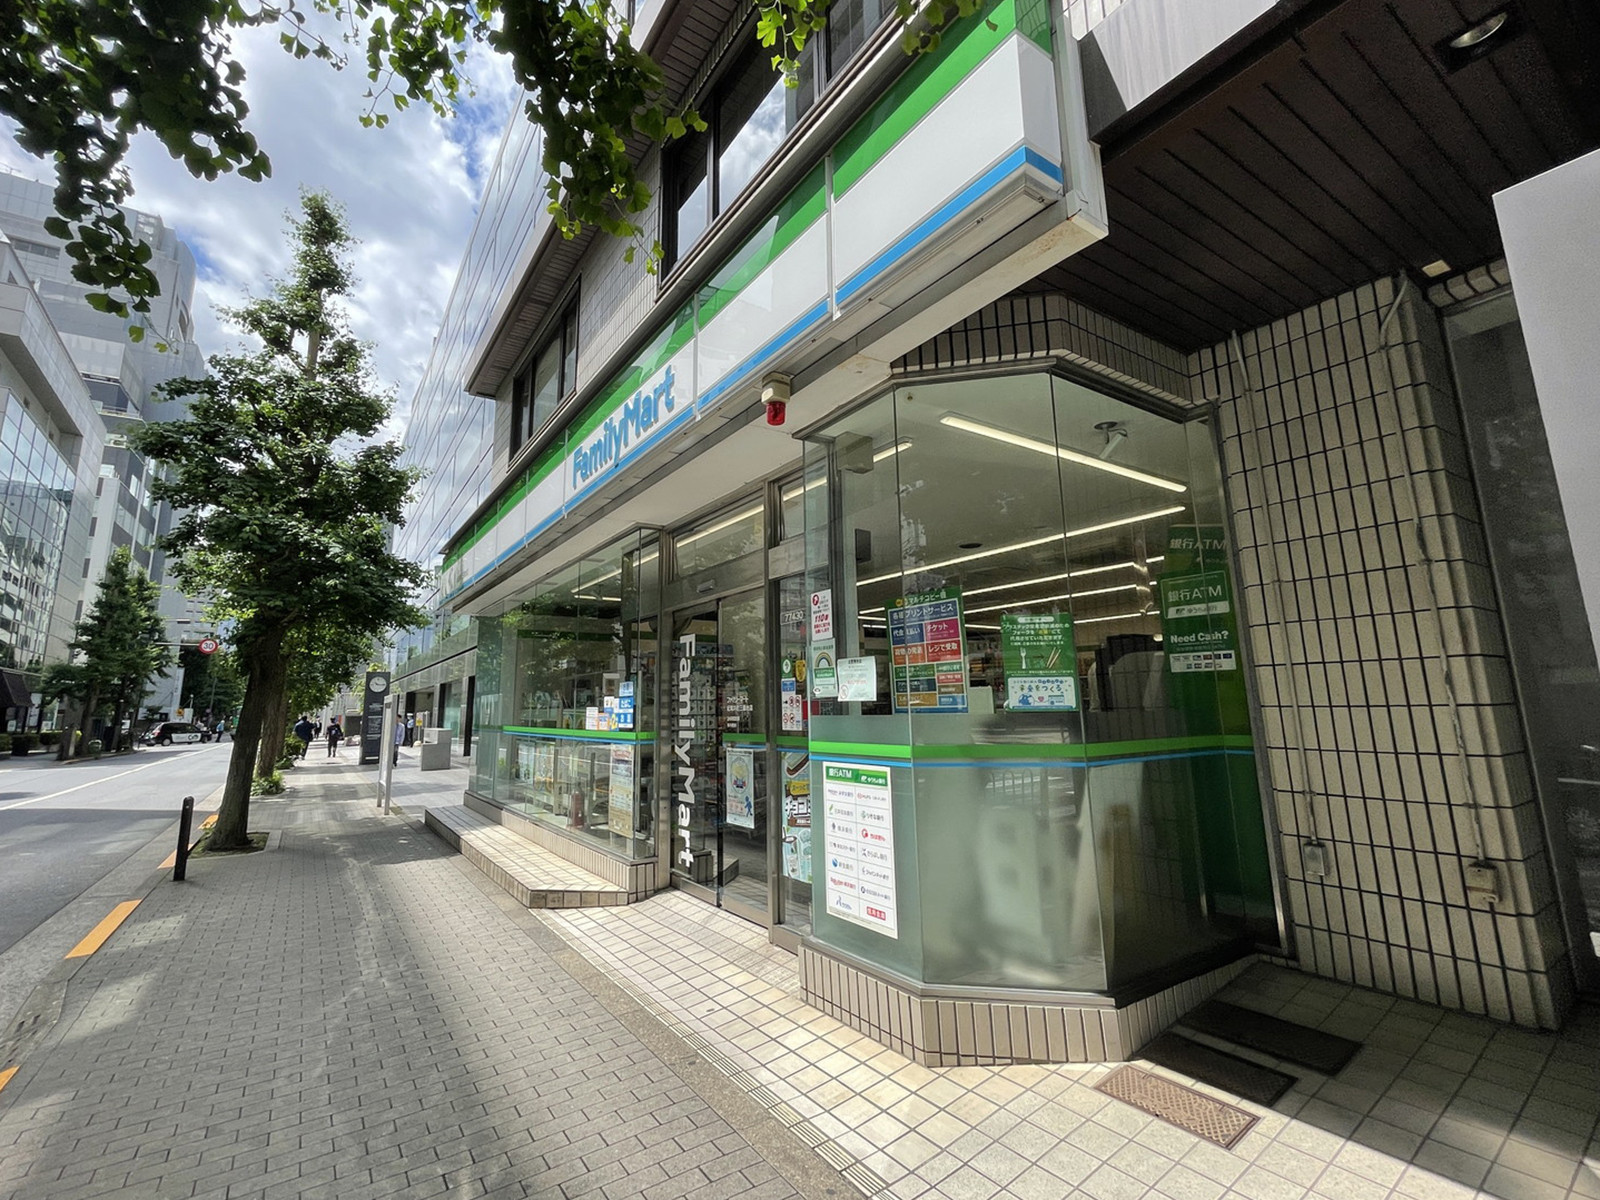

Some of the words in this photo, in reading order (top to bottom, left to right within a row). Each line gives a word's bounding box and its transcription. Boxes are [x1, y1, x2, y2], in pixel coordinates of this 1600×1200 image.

[573, 365, 675, 489] FamilyMart
[1167, 585, 1222, 602] 銀行ATM
[784, 611, 804, 623] 77430
[926, 622, 949, 633] チケット
[1170, 632, 1196, 644] Need
[1197, 630, 1229, 642] Cash?
[203, 642, 214, 650] 30
[674, 633, 696, 868] FamilyMart
